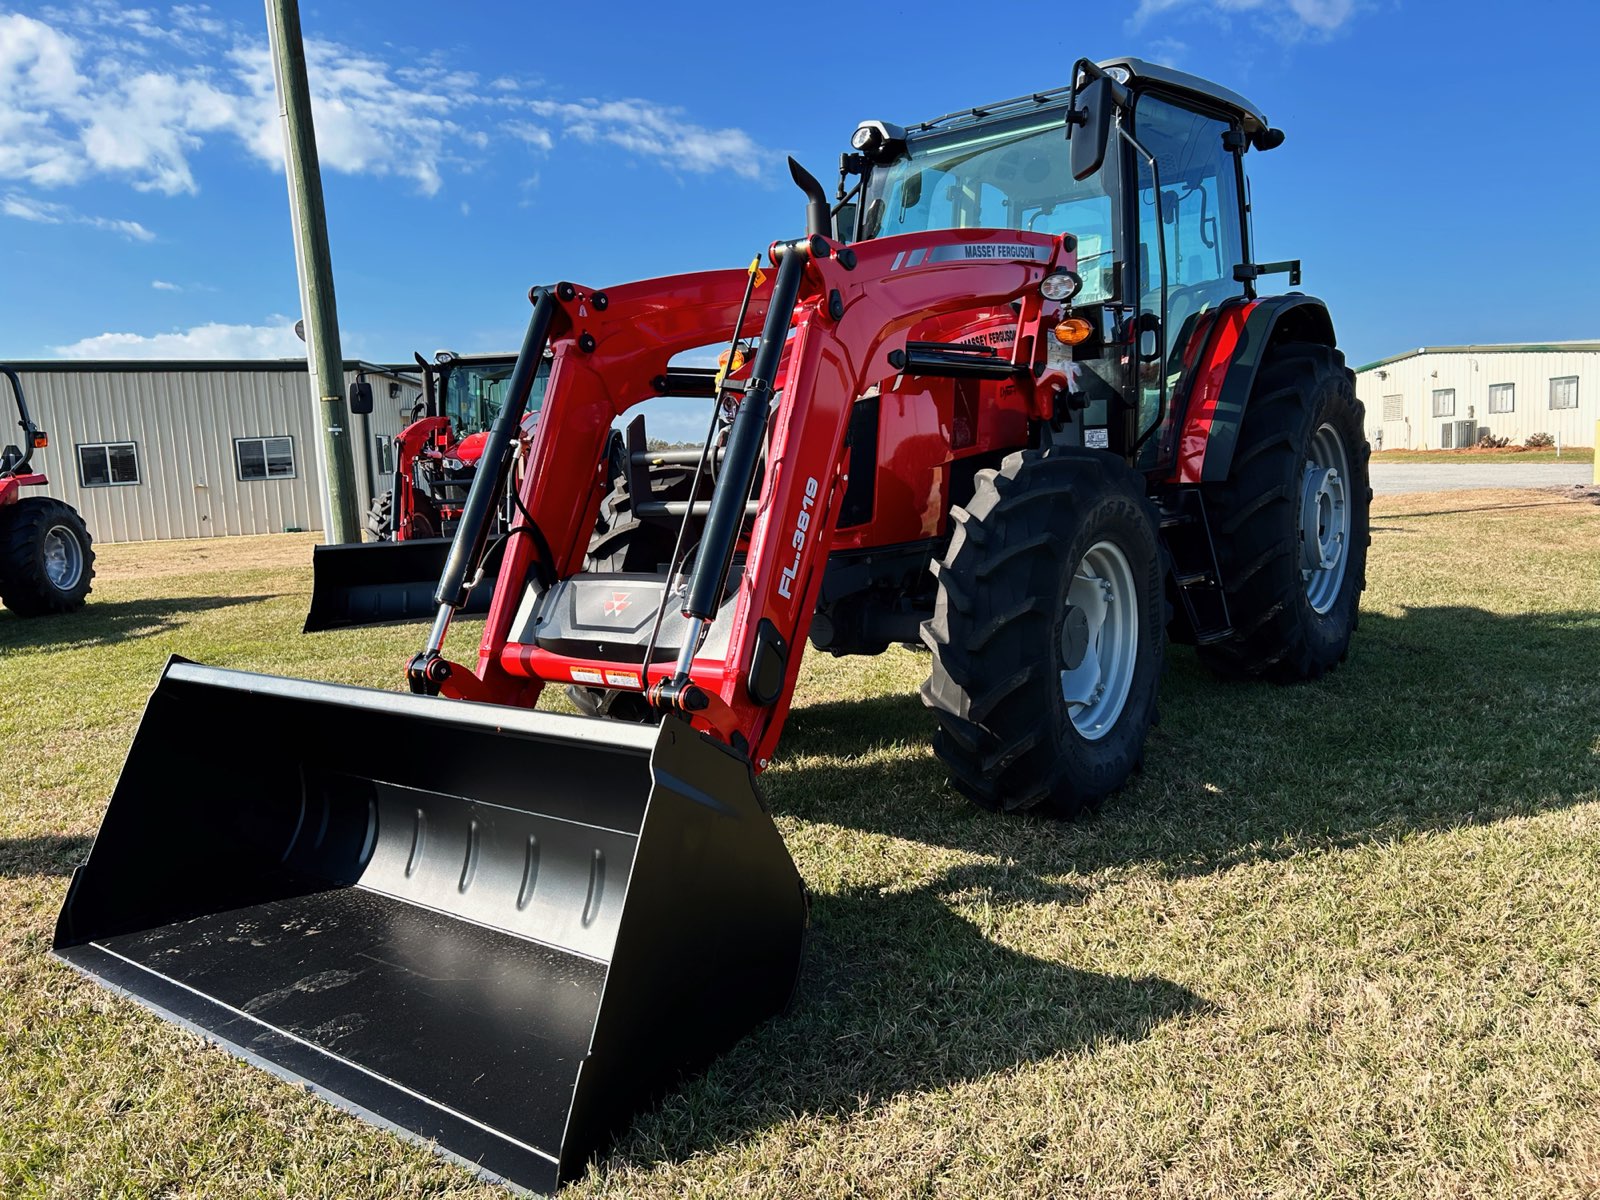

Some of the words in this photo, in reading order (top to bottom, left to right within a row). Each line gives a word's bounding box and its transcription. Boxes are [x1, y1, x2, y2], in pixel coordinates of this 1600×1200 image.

[965, 245, 996, 259] MASSEY
[997, 245, 1035, 259] FERGUSON
[778, 476, 819, 600] FL.3819
